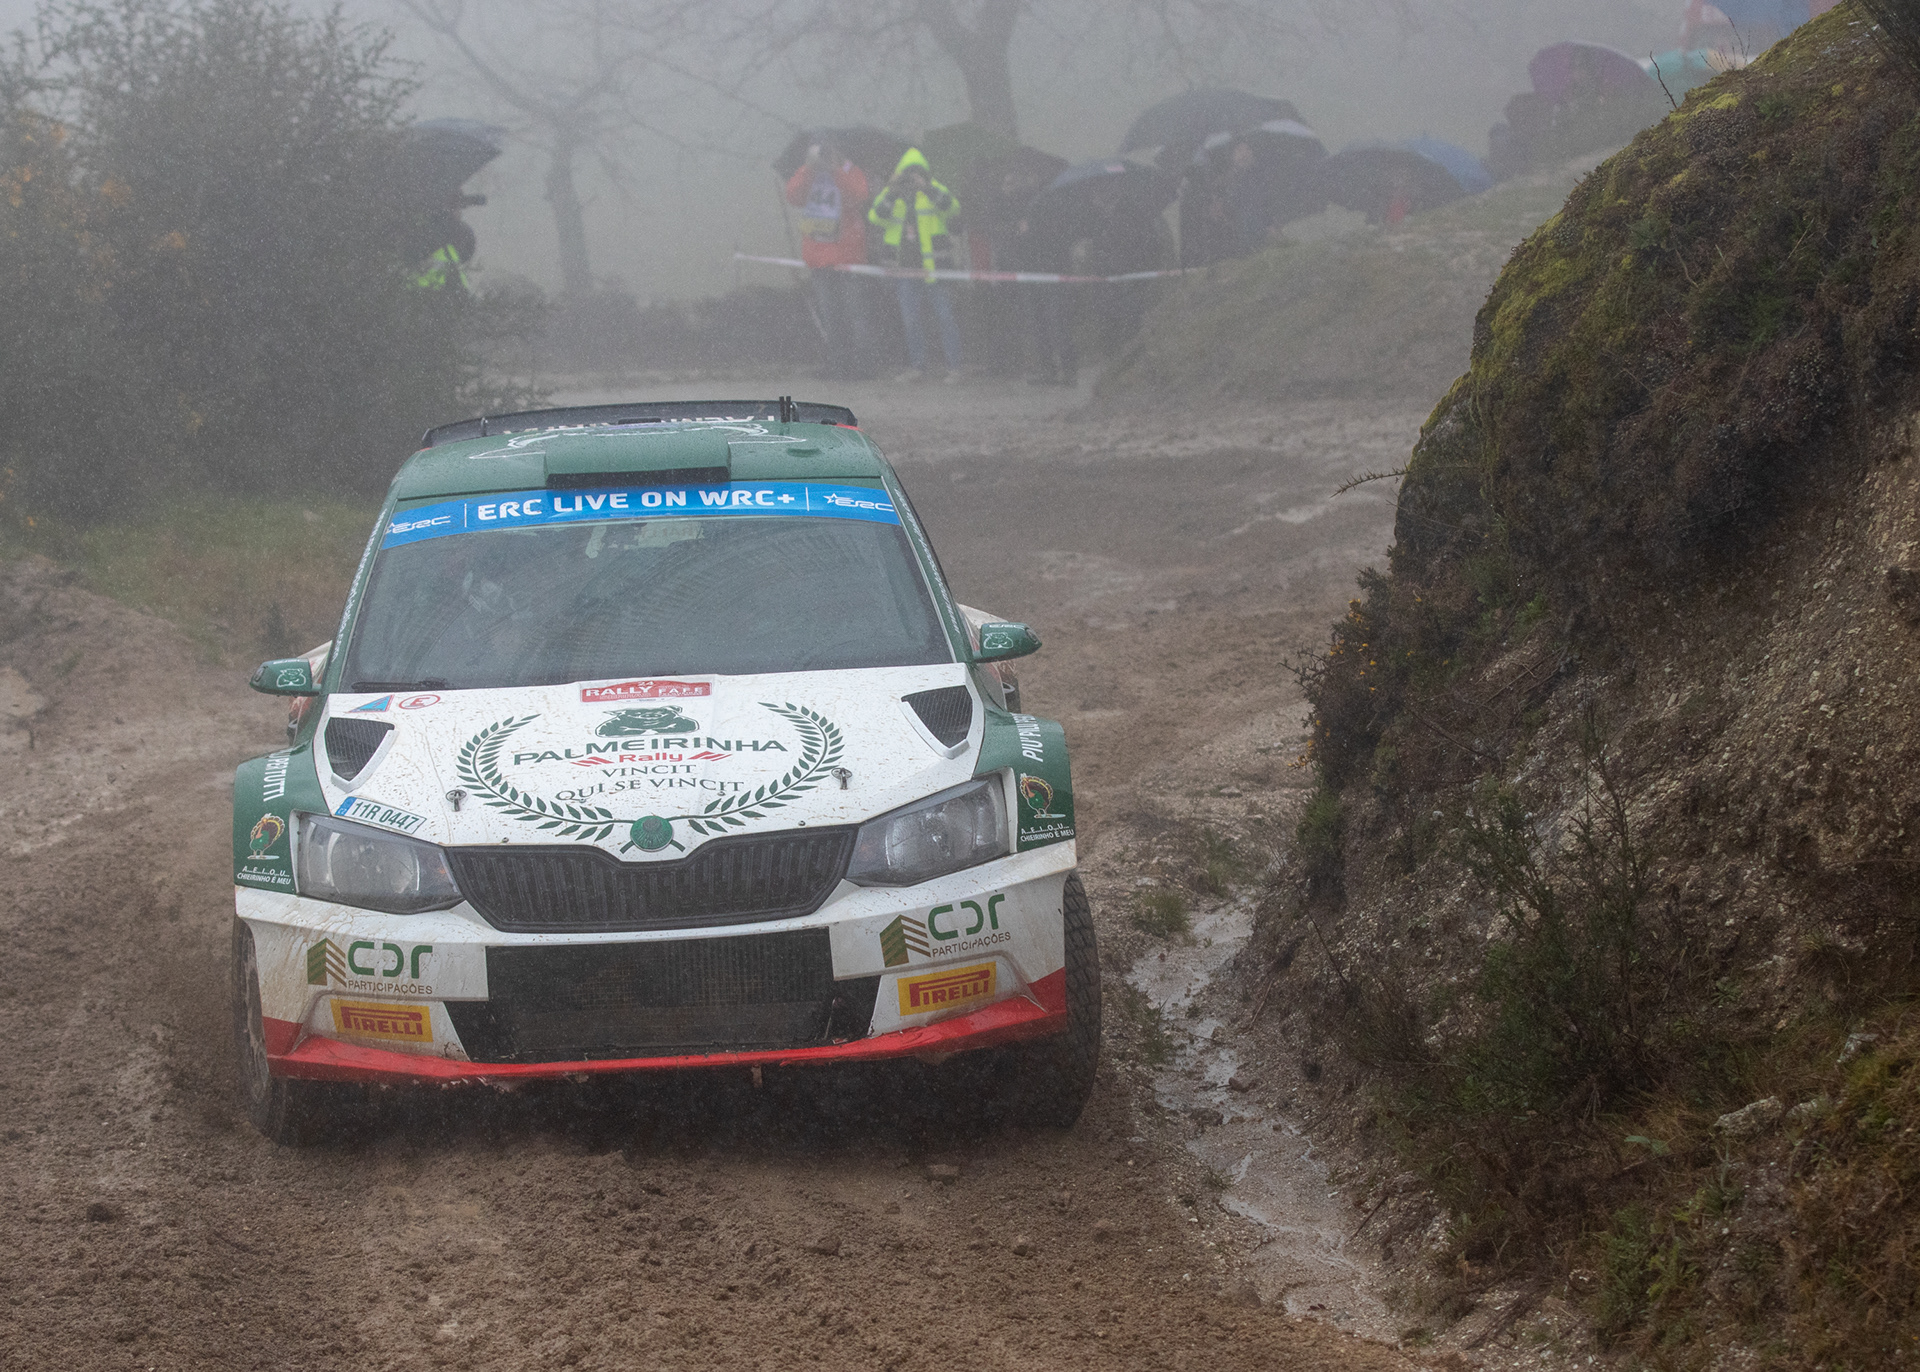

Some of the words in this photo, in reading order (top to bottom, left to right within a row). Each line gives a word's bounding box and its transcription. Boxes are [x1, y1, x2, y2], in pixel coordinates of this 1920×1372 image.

[477, 498, 543, 521] ERC
[553, 492, 629, 512] LIVE
[641, 490, 687, 507] ON
[698, 489, 795, 507] WRC+
[585, 685, 653, 697] RALLY
[513, 736, 788, 766] PALMEIRINHA
[618, 751, 683, 763] Rally
[601, 764, 696, 778] VINCIT
[555, 783, 605, 802] QUI
[614, 779, 642, 792] SE
[649, 778, 744, 793] VINCIT
[378, 809, 419, 830] 0447
[909, 969, 991, 1008] PIRELLI
[340, 1006, 424, 1036] PIRELLI
